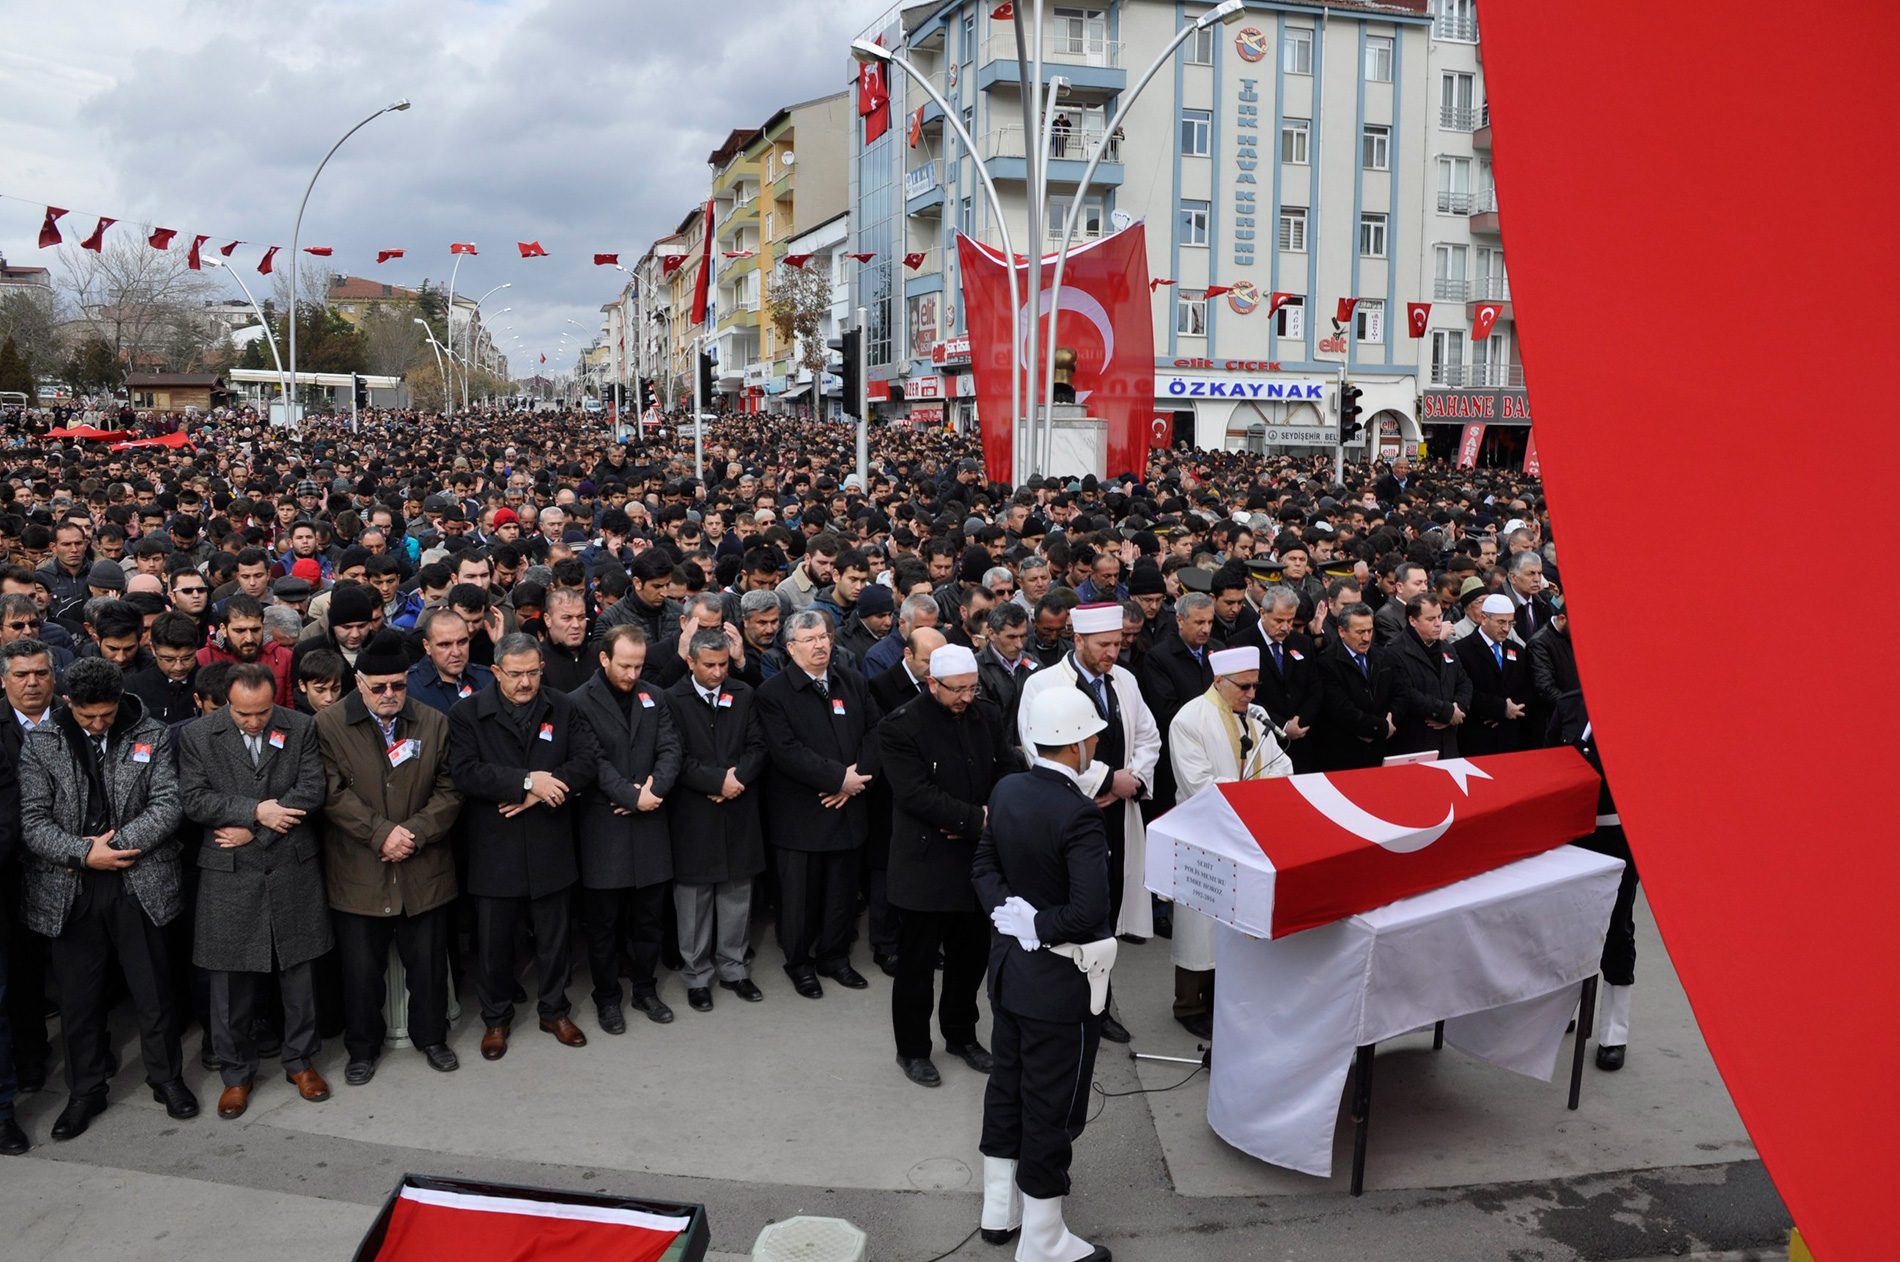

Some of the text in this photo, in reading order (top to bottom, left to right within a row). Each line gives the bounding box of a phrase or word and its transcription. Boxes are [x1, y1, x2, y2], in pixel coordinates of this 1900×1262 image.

[1237, 78, 1258, 128] TÜRK
[1236, 134, 1258, 184] HAVA
[1234, 190, 1256, 266] KURUMU
[921, 297, 936, 326] elit
[1319, 337, 1347, 353] elit
[1174, 358, 1213, 369] elit
[1169, 378, 1323, 398] ÖZKAYNAK
